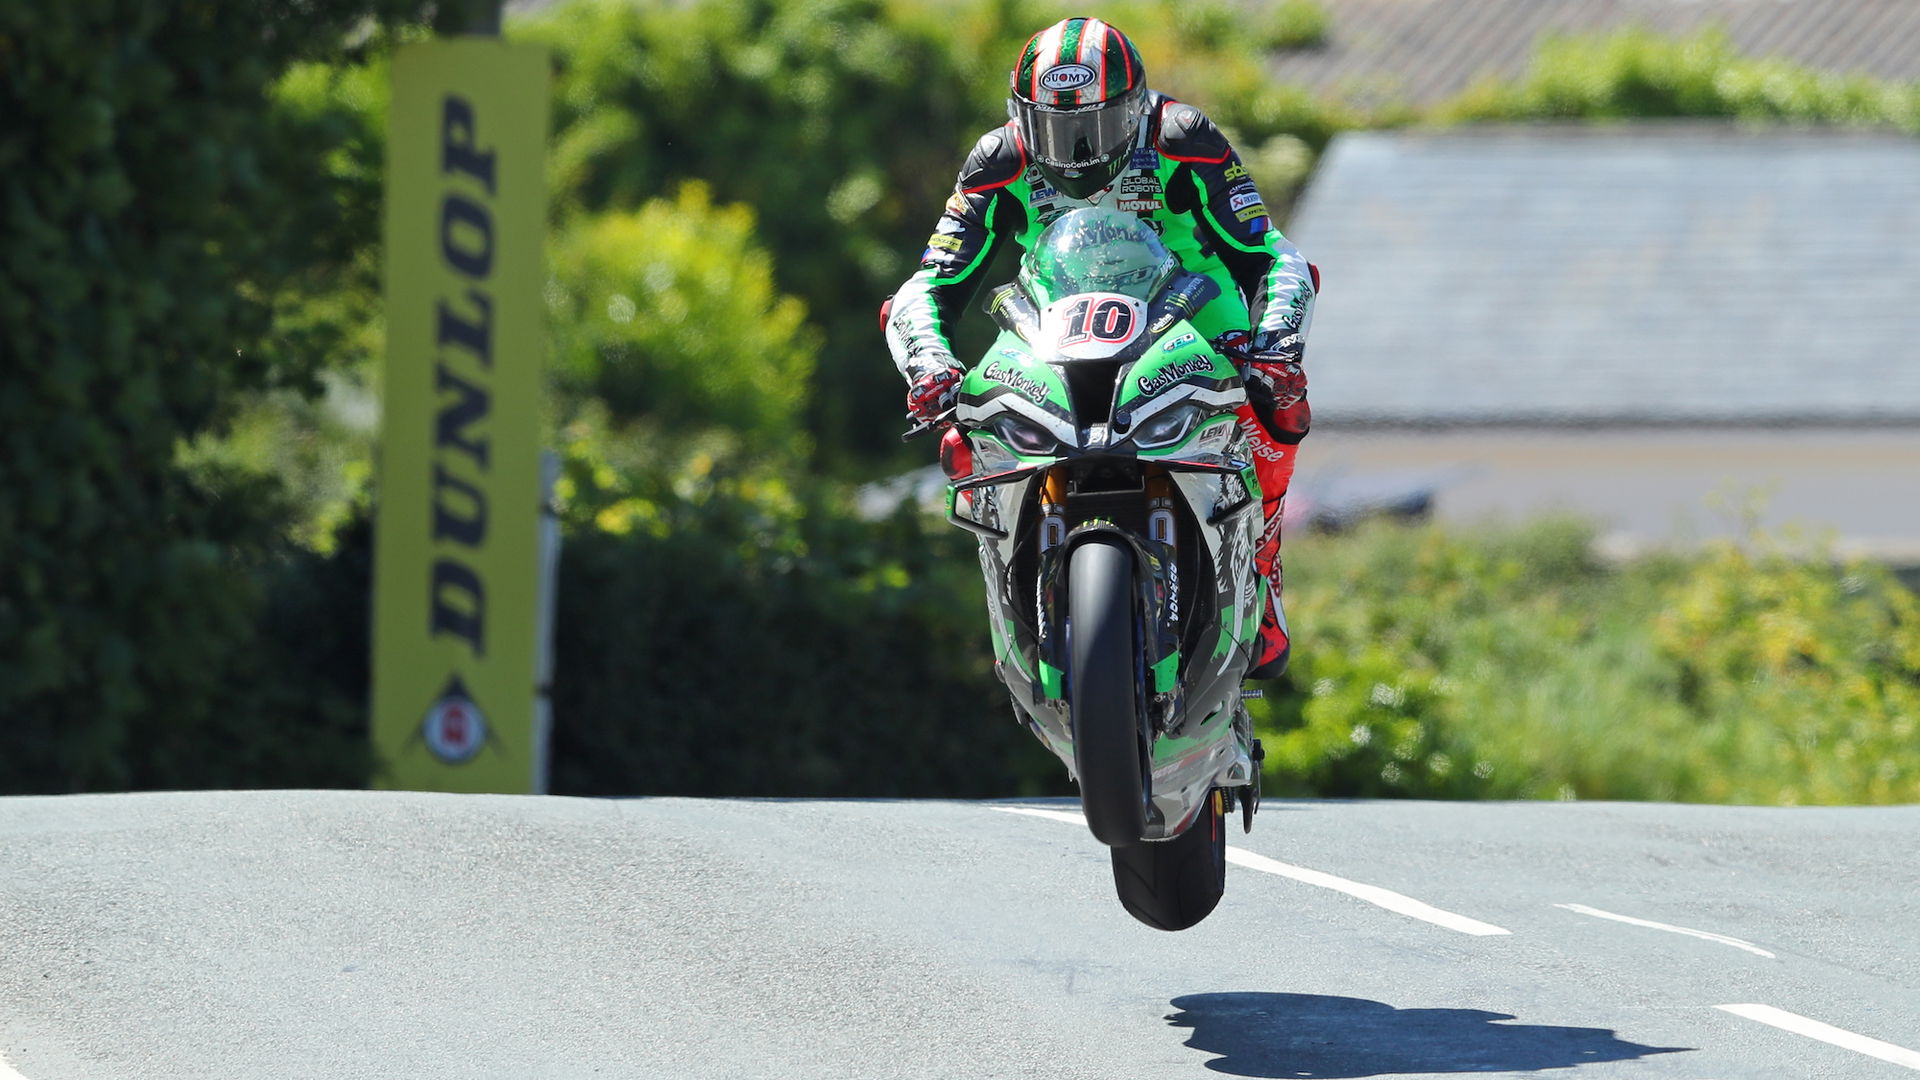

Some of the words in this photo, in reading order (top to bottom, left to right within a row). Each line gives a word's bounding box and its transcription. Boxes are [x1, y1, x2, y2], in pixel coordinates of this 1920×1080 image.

[1045, 73, 1089, 83] SUOMY
[1121, 184, 1162, 194] ROBOTS
[1122, 177, 1160, 186] GLOBAL
[1119, 200, 1162, 211] MOTUL
[1059, 298, 1135, 347] 10
[431, 95, 498, 660] DUNLOP
[983, 360, 1051, 405] GasMonkey
[1137, 354, 1214, 397] GasMonkey
[1241, 417, 1285, 462] Weise
